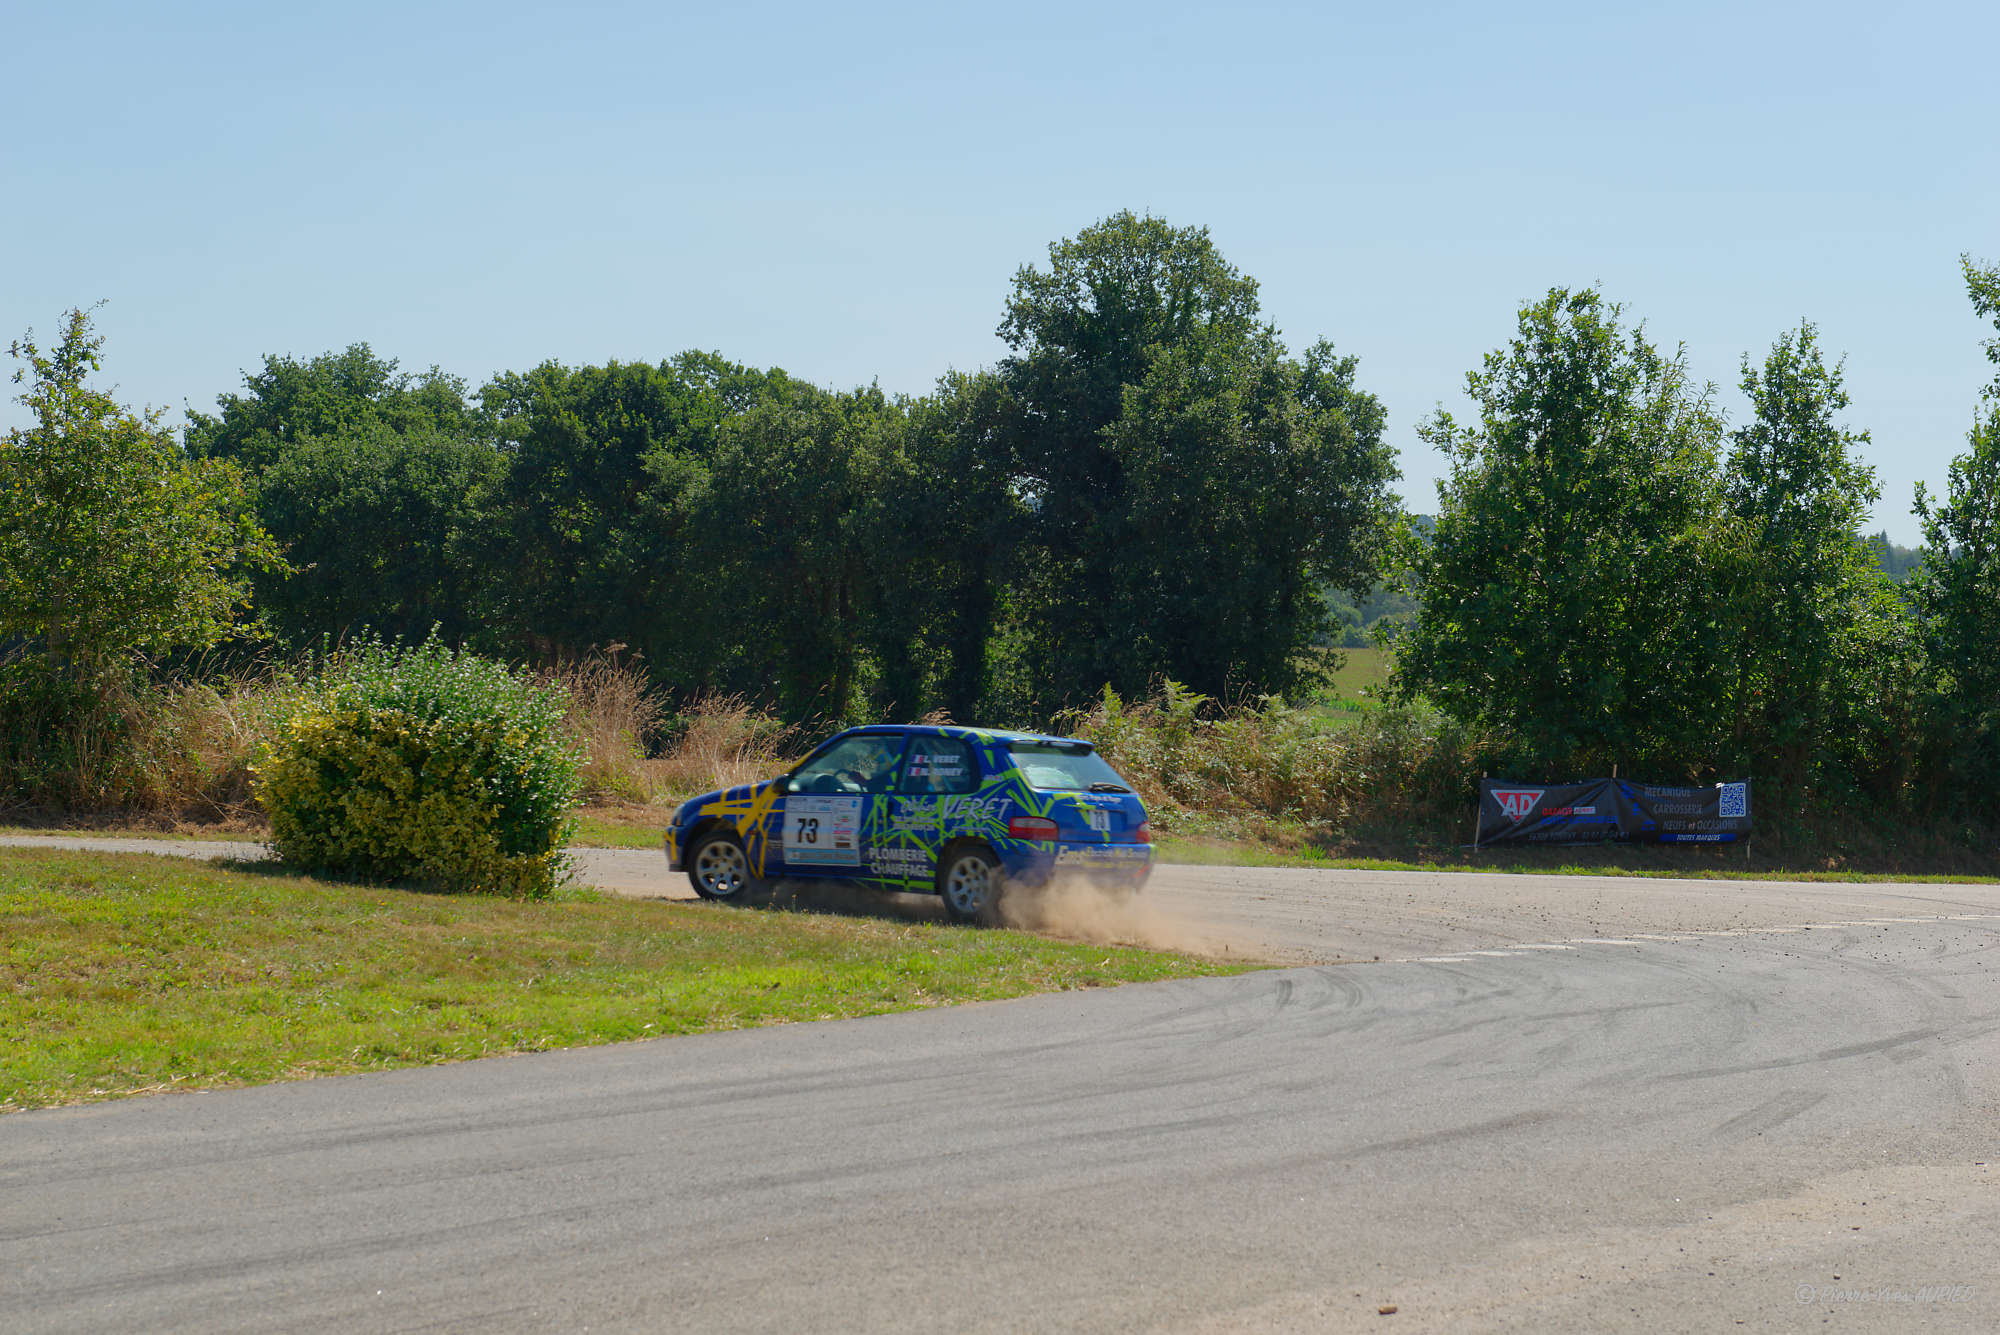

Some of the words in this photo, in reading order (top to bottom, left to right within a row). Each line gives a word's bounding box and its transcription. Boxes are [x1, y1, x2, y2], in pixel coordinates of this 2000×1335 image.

[943, 795, 1013, 820] VERET
[1501, 794, 1533, 816] AD
[797, 818, 818, 843] 73
[868, 847, 928, 863] PLOMBERIE
[870, 862, 929, 878] CHAUFFAGE
